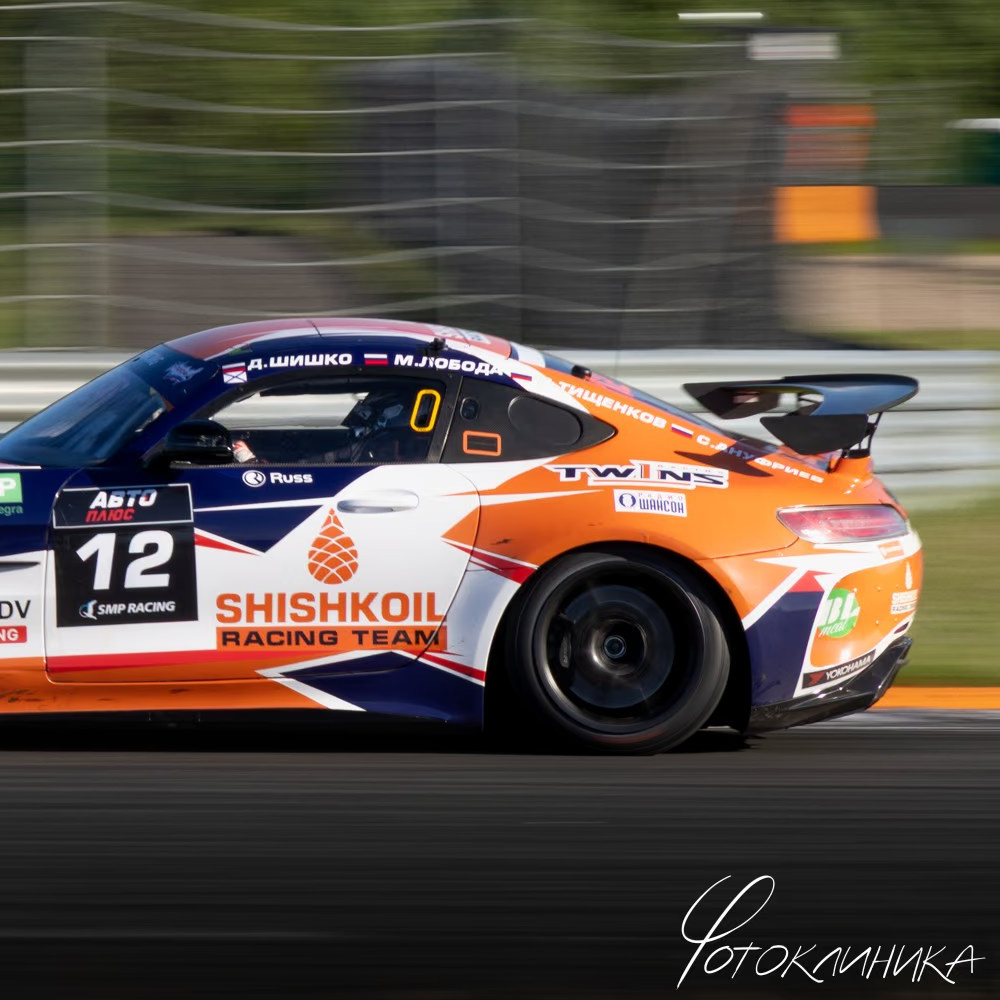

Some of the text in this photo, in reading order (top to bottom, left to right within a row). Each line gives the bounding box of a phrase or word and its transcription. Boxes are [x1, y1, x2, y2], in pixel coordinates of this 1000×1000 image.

[247, 353, 353, 372] Д.ШИШКО
[269, 472, 314, 484] Russ
[639, 498, 684, 514] ШАНСОН
[85, 508, 135, 523] ПЛЮС
[76, 529, 174, 590] 12
[97, 601, 176, 615] SMP RACING
[216, 592, 447, 624] SHISHKOIL
[221, 630, 440, 646] RACING TEAM
[825, 655, 872, 680] YOKOHAMA
